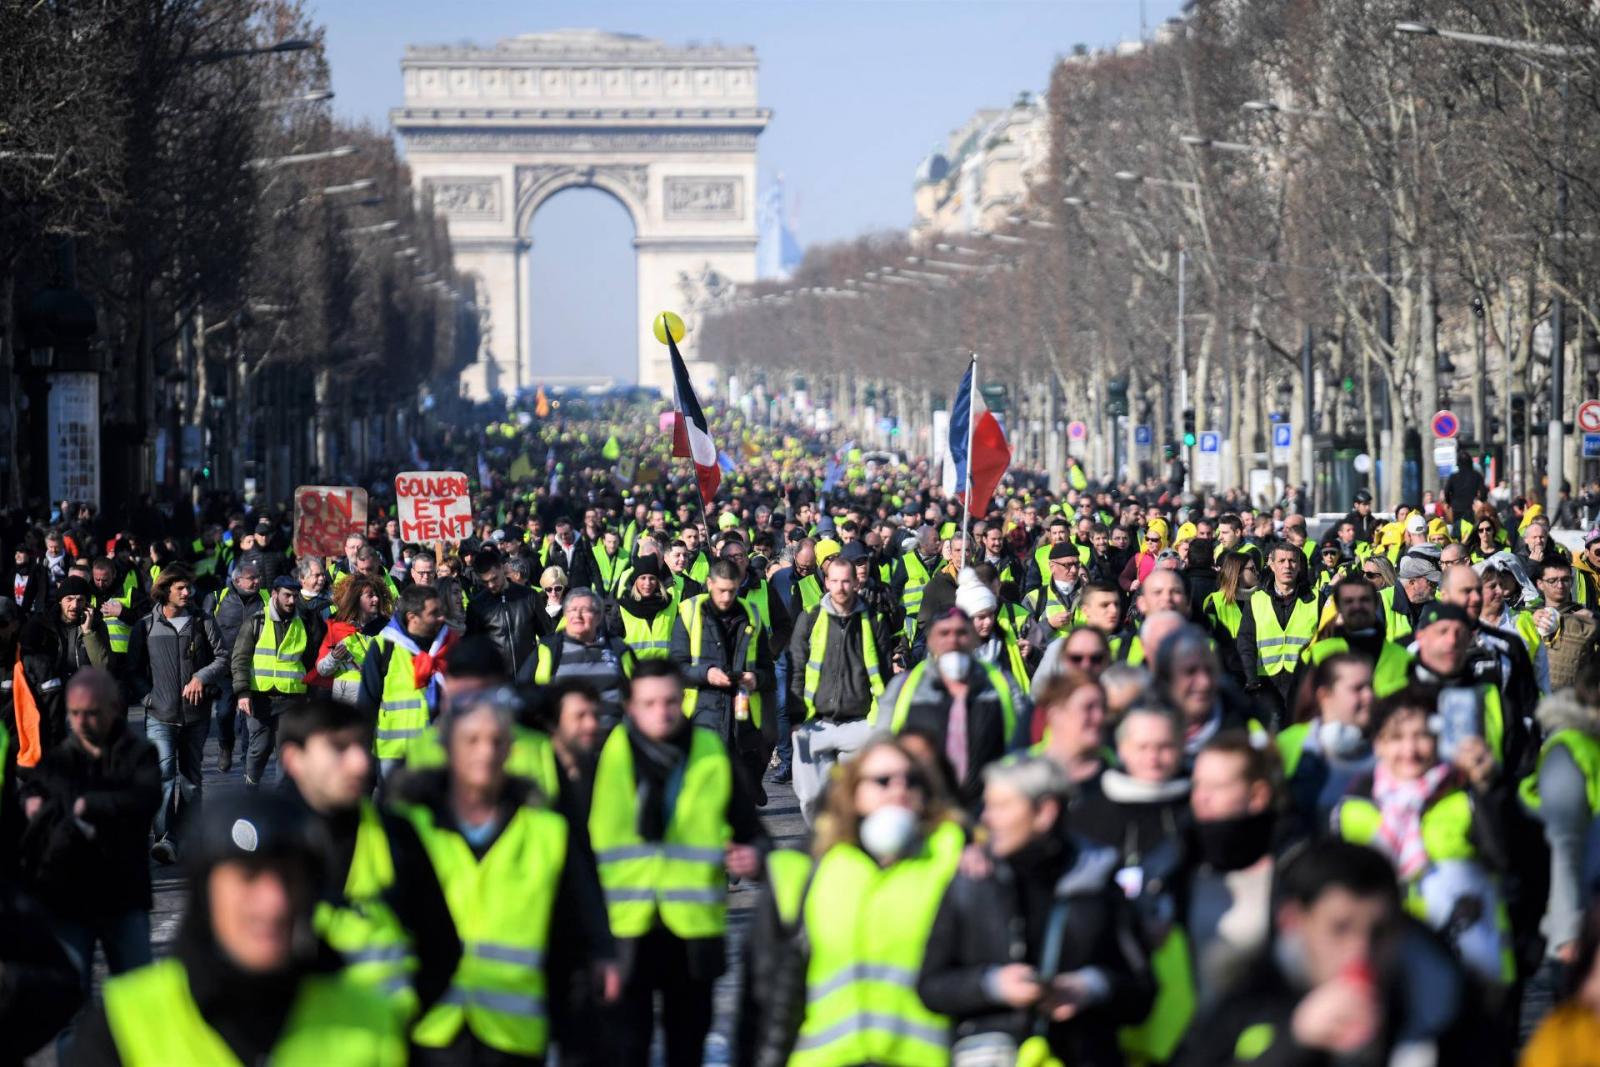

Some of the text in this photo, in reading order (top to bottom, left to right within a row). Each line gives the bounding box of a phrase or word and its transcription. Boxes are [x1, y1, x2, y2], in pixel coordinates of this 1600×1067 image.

[300, 488, 352, 519] ON
[414, 498, 457, 520] ET
[402, 514, 472, 542] MENT
